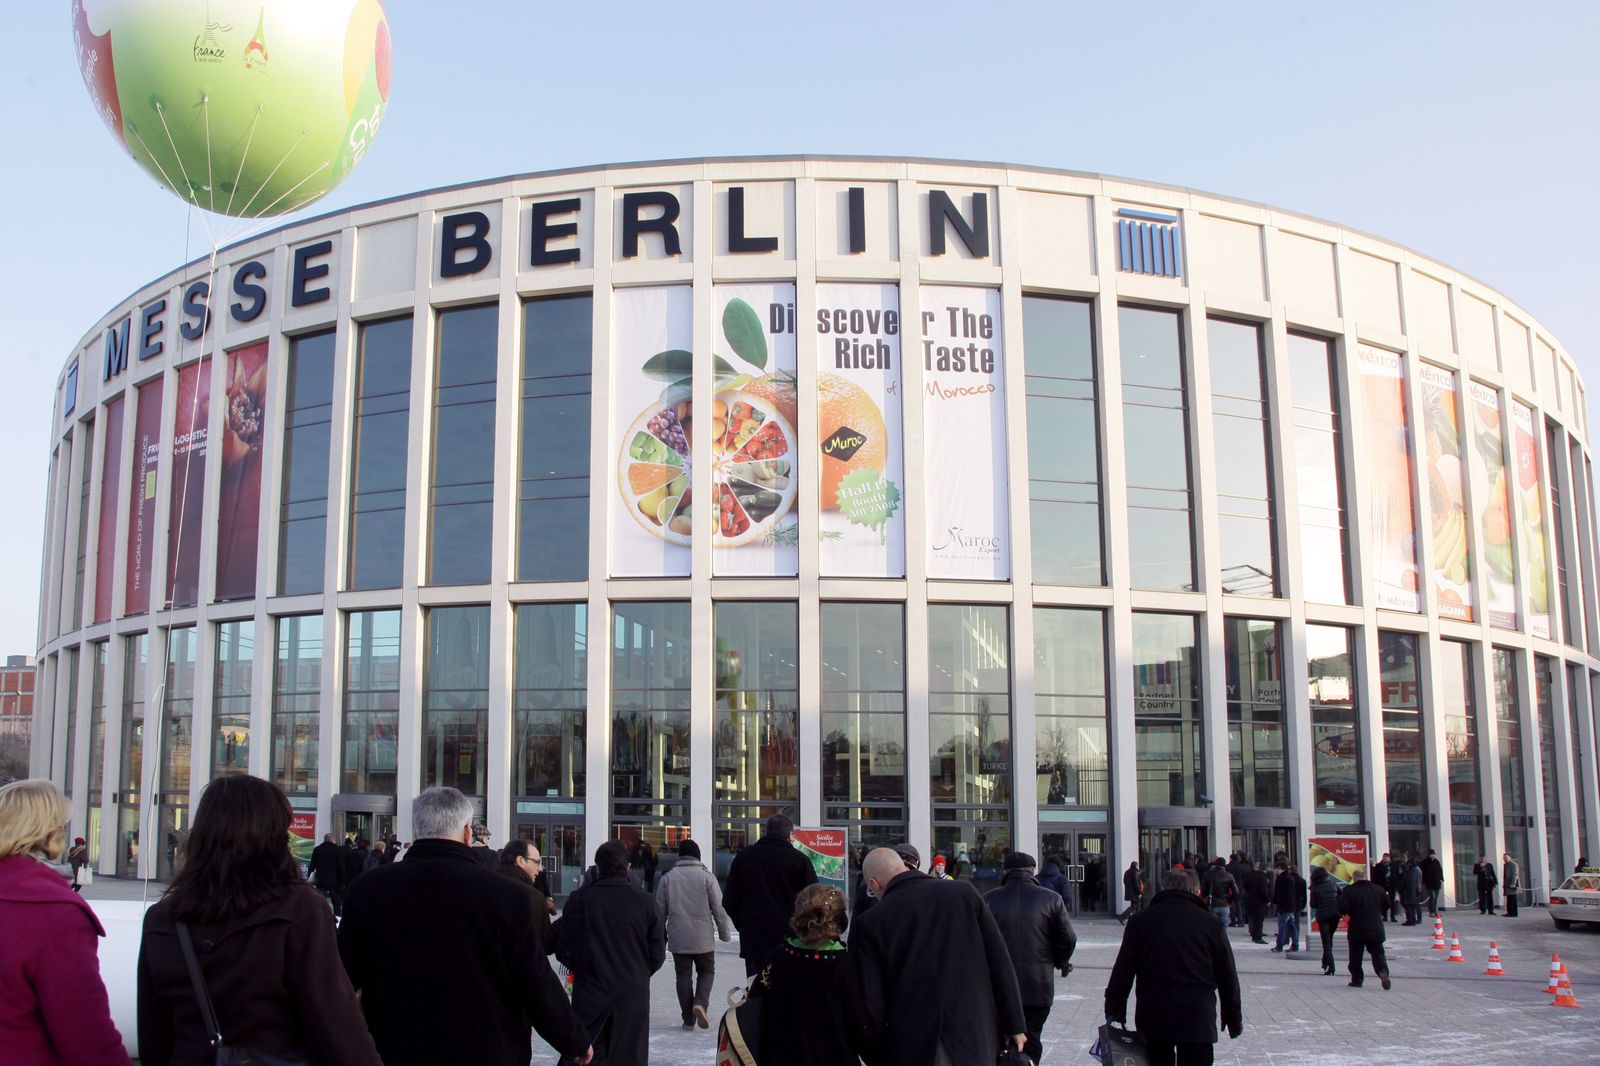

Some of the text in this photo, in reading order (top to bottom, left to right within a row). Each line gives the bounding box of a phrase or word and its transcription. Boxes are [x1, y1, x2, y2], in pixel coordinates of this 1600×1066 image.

[103, 186, 989, 382] MESSE BERLIN
[946, 306, 994, 340] The
[835, 337, 995, 374] Rich Taste
[886, 380, 996, 400] of Morocco
[174, 428, 208, 446] LOGISTIC
[841, 482, 872, 498] Hall
[852, 494, 886, 507] Booth
[1139, 701, 1175, 710] Country
[983, 762, 1009, 770] TURKE
